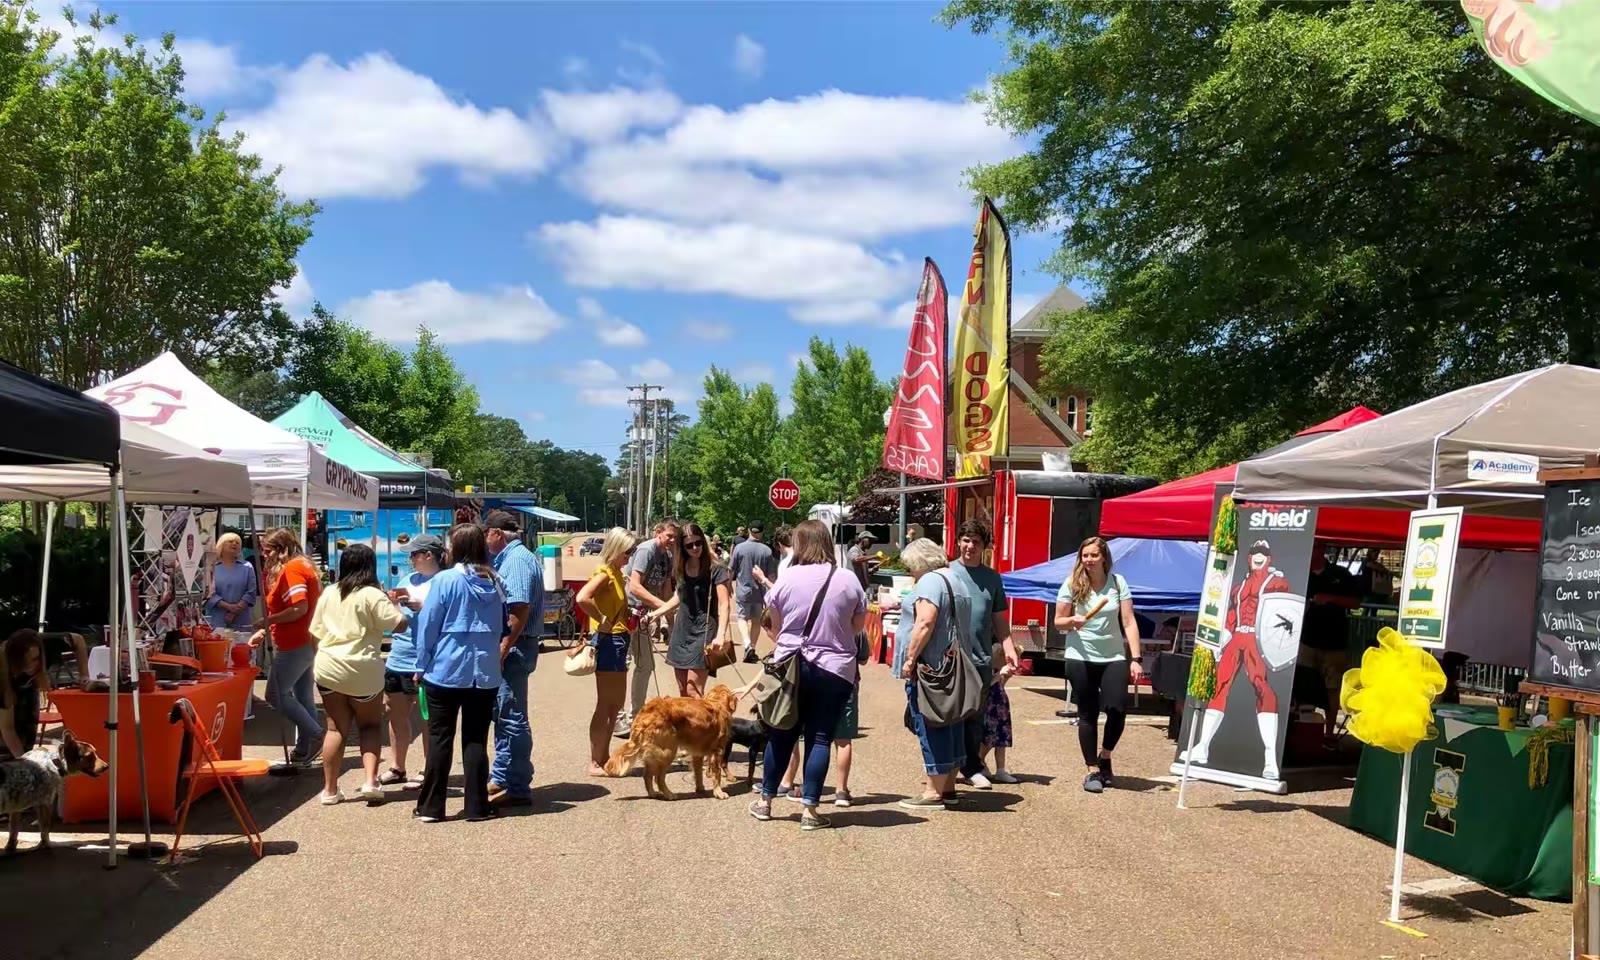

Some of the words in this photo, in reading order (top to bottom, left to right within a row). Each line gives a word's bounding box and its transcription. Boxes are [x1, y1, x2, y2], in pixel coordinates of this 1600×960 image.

[285, 427, 333, 437] newal
[1488, 460, 1534, 474] Academy
[326, 458, 368, 501] GRYPHONS
[772, 488, 798, 500] STOP
[1567, 489, 1591, 506] Ice
[1249, 508, 1308, 527] shield
[1567, 544, 1577, 561] 2
[1565, 566, 1574, 582] 3
[1556, 587, 1580, 600] Cone
[1543, 612, 1584, 632] Vanilla
[1550, 655, 1591, 678] Butter
